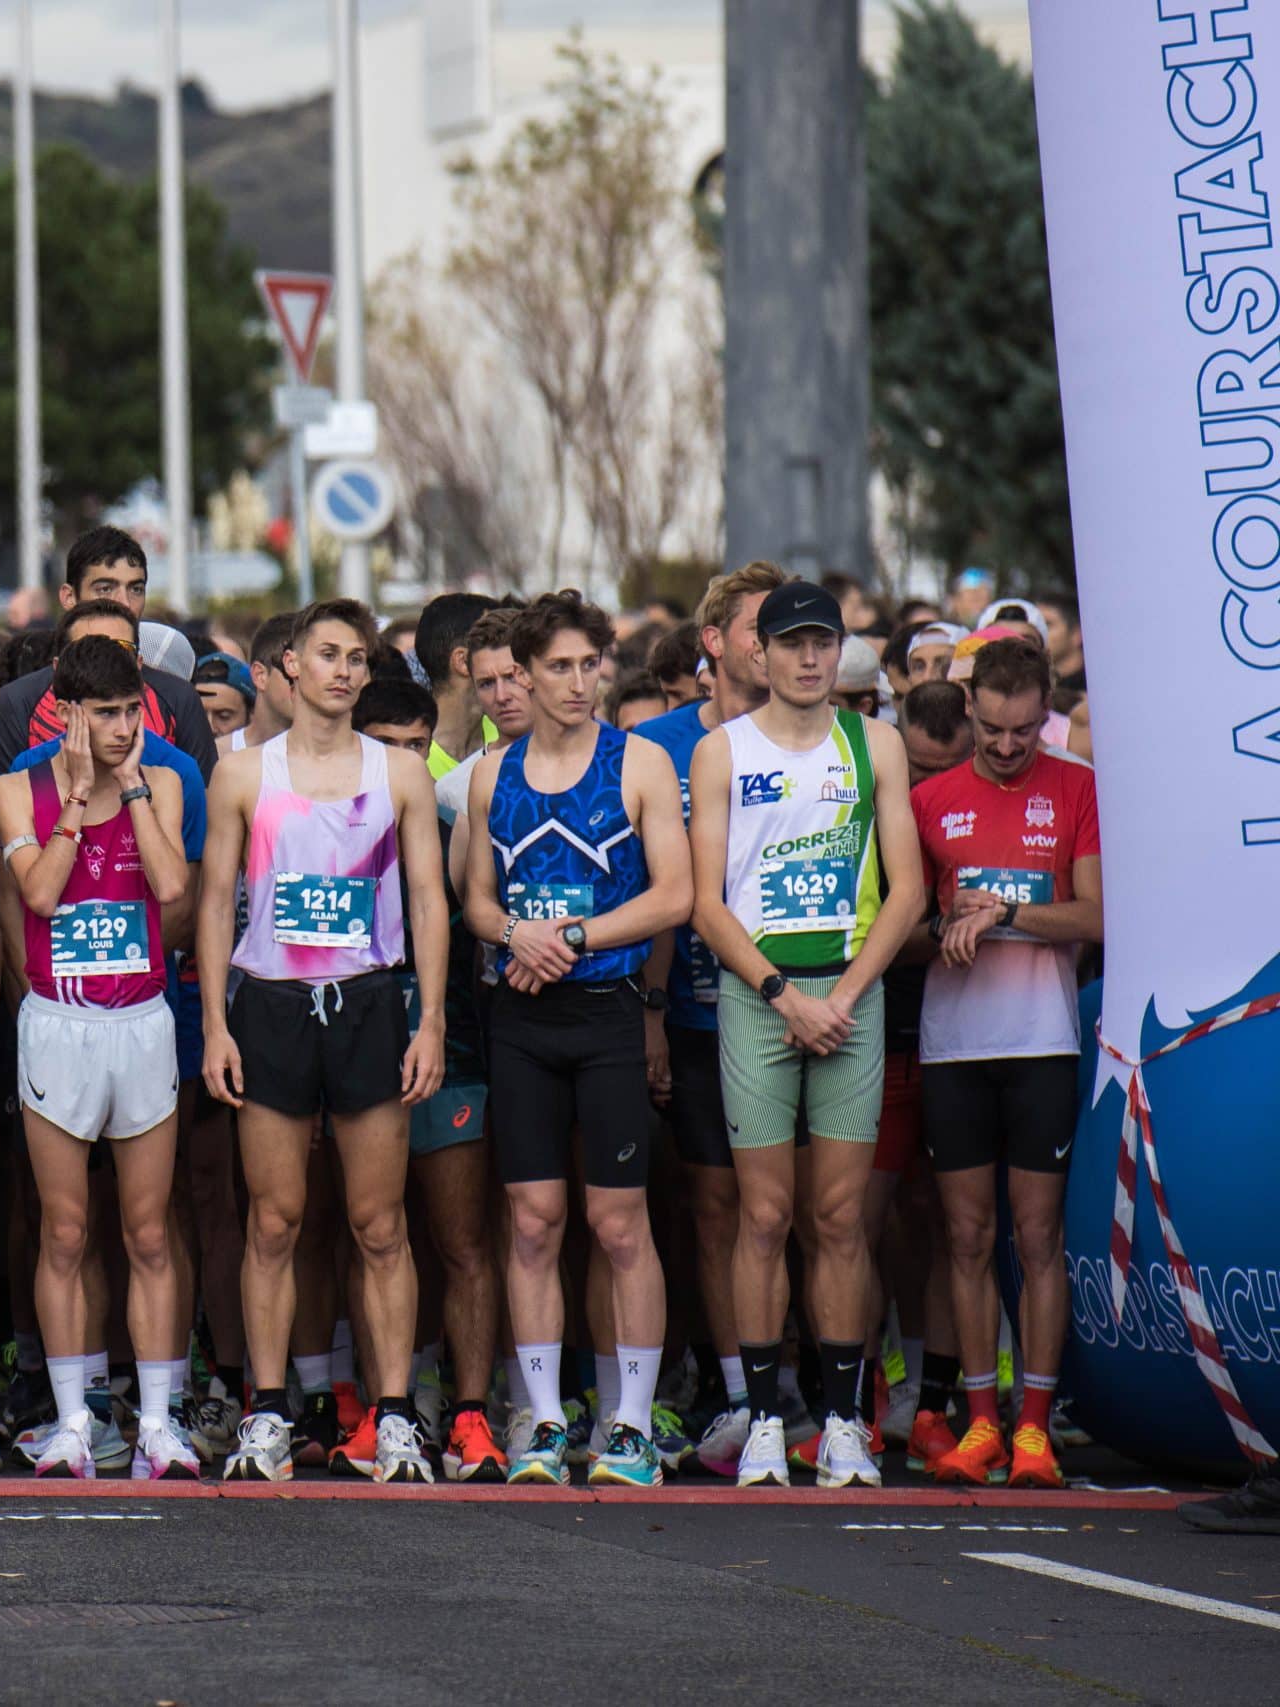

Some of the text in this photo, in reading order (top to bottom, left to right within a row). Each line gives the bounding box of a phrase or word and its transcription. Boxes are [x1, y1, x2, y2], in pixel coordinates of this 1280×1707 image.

[738, 771, 784, 796] TAC
[834, 788, 858, 799] TULLE
[1021, 833, 1057, 848] wtw
[782, 873, 838, 897] 1629
[300, 888, 352, 912] 1214
[799, 896, 825, 906] ARNO
[310, 912, 338, 921] ALBAN
[524, 899, 569, 919] 1215
[72, 917, 128, 940] 2129
[88, 940, 114, 949] LOUIS
